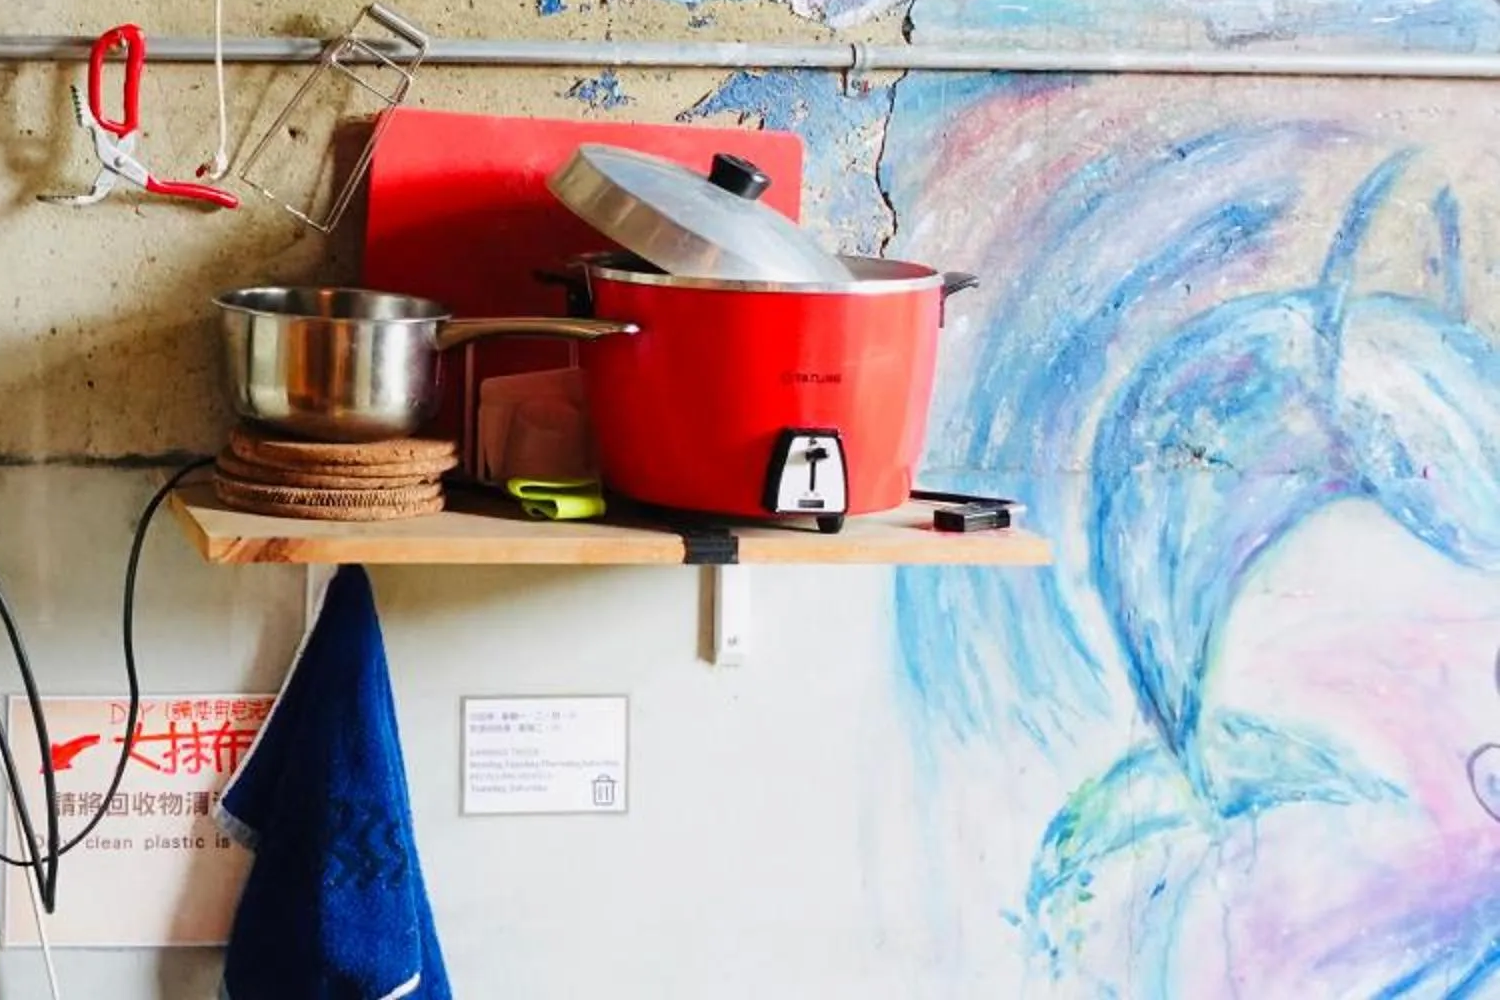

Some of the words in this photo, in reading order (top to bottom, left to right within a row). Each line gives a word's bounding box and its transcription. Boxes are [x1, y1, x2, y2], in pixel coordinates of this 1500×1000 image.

[54, 790, 223, 817] 請將回收物清
[85, 834, 133, 849] clean
[144, 834, 205, 850] plastic
[215, 833, 230, 849] is
